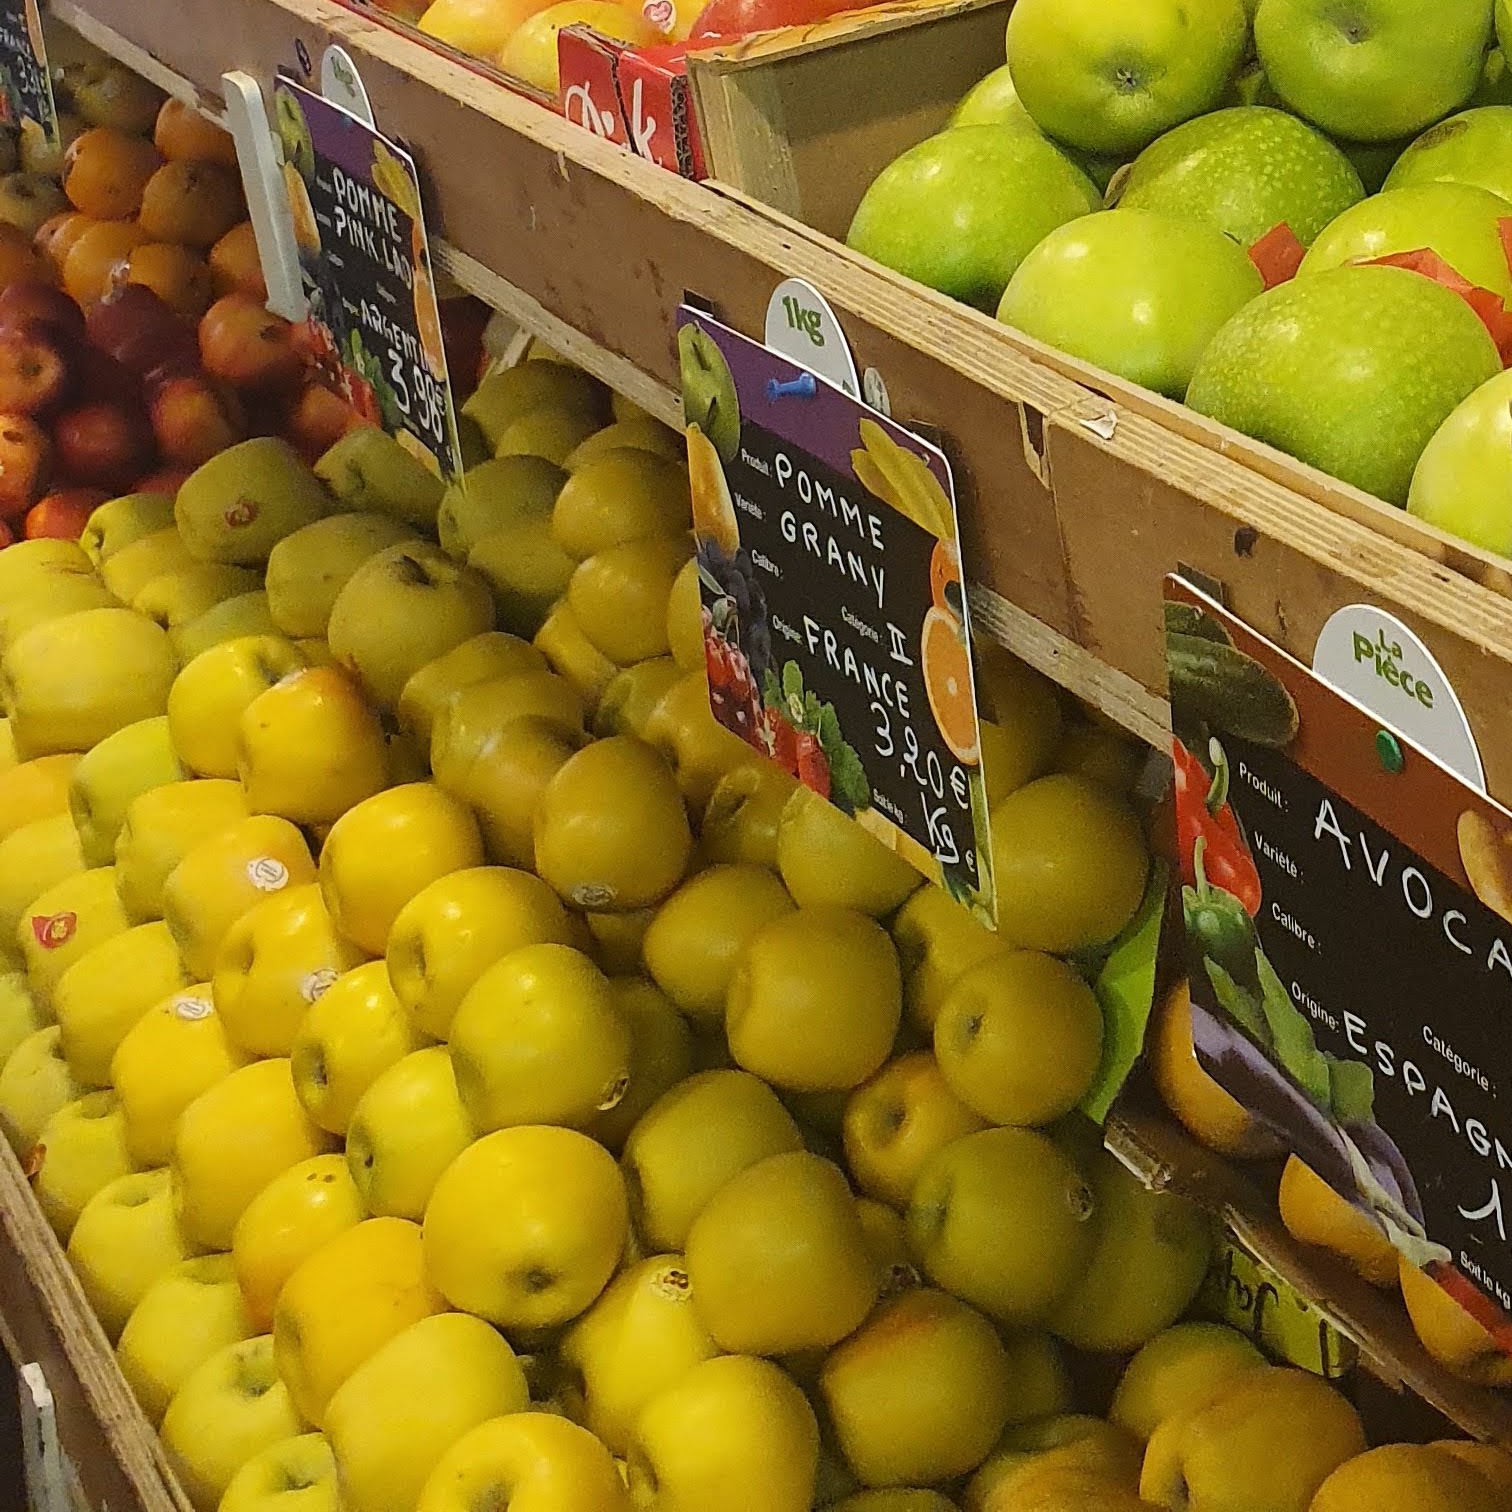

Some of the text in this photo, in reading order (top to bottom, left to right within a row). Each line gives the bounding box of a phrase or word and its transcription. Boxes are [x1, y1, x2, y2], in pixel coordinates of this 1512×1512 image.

[333, 167, 402, 243] POMME
[334, 204, 379, 263] PINK
[782, 295, 825, 348] 1kg
[775, 452, 885, 551] POMME
[780, 510, 885, 609] GRANY
[803, 614, 910, 719] FRANCE
[1379, 628, 1402, 661] La
[1239, 761, 1282, 809] Produit
[1254, 831, 1298, 878] Variété
[1272, 902, 1316, 949] Calibre
[1423, 1025, 1489, 1092] Catégorie
